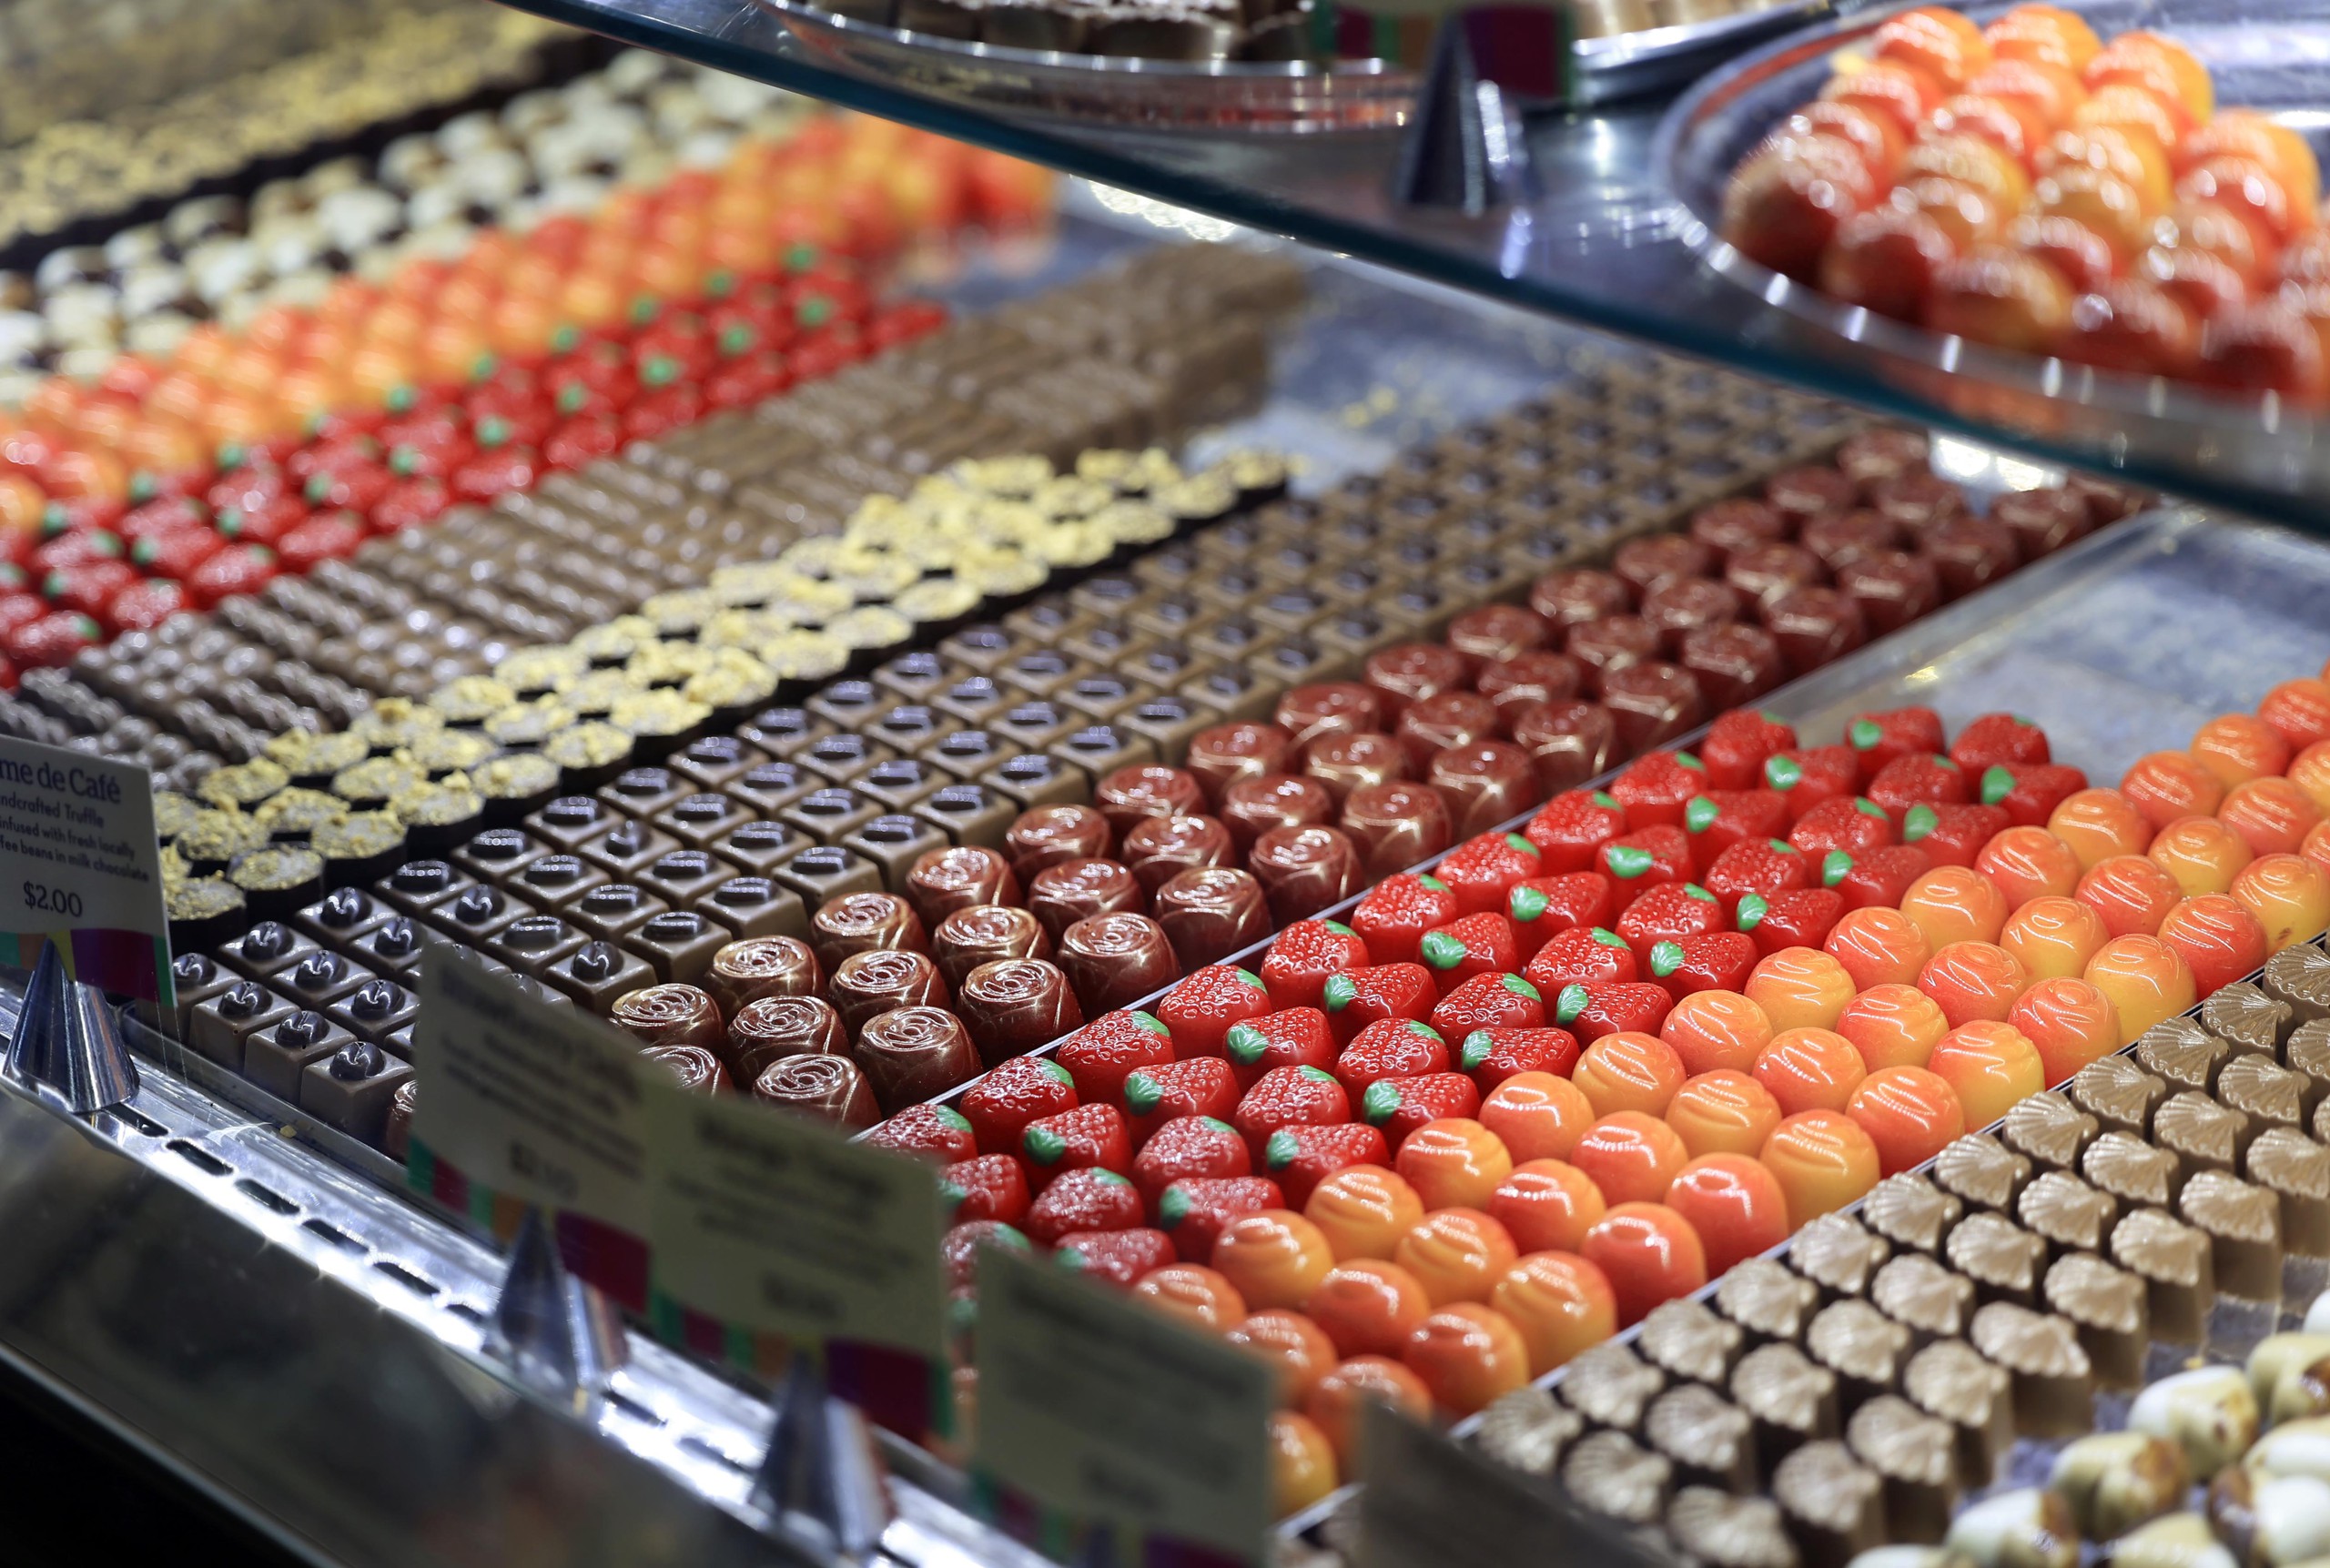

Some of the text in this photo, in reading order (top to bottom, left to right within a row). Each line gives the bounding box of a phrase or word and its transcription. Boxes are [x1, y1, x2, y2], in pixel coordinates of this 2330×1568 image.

[37, 762, 66, 792] de
[69, 766, 121, 804] Café
[0, 792, 104, 829] ndcrafted Truffle
[20, 840, 53, 861] beans
[56, 849, 66, 864] in
[68, 853, 91, 869] milk
[94, 858, 148, 881] chocolate
[42, 827, 66, 843] with
[68, 829, 96, 849] fresh
[99, 837, 135, 862] locally
[24, 880, 83, 918] $2.00
